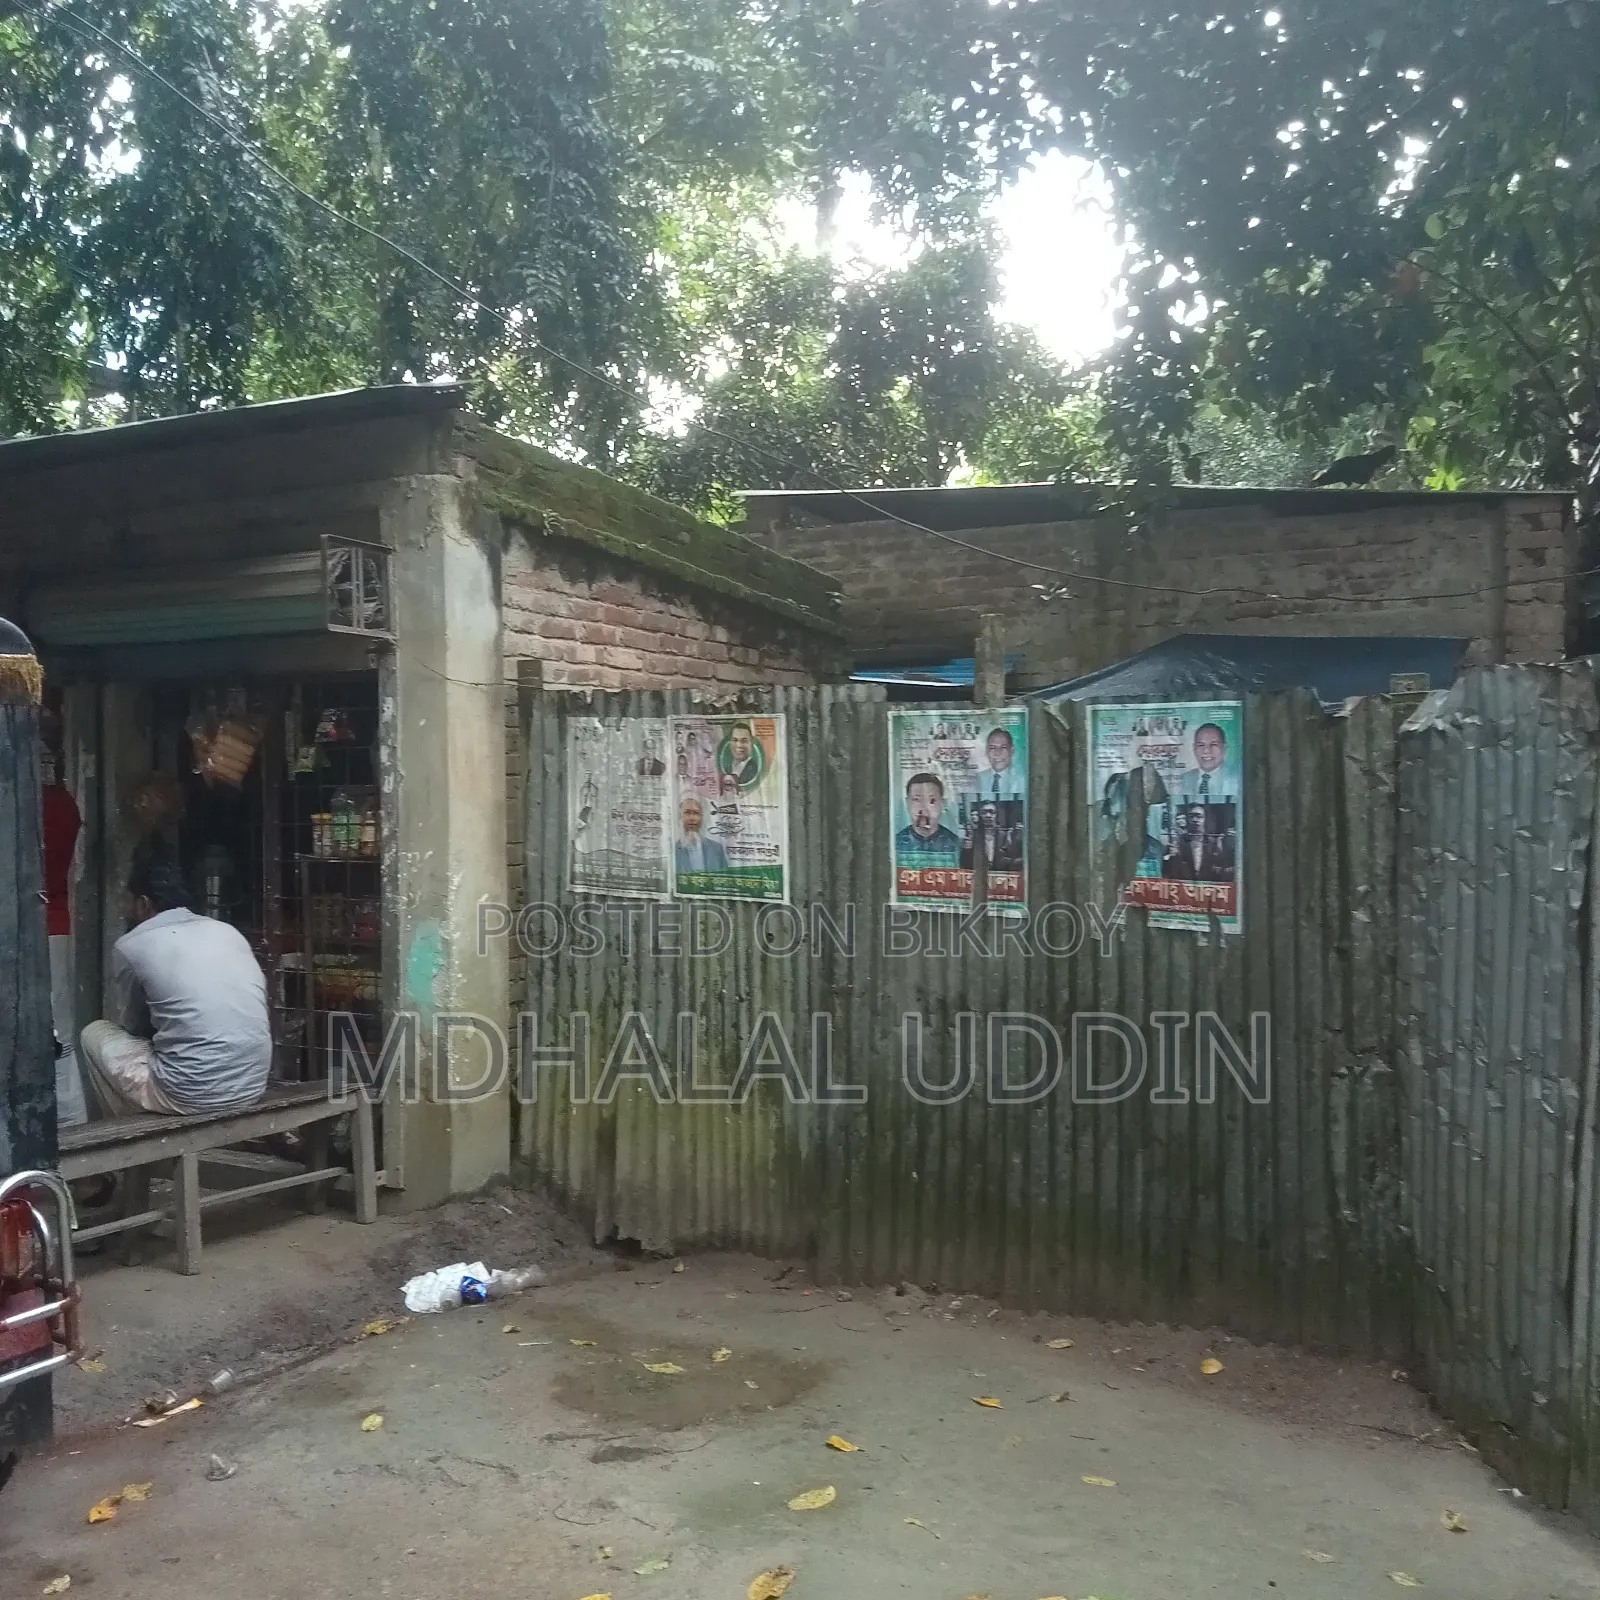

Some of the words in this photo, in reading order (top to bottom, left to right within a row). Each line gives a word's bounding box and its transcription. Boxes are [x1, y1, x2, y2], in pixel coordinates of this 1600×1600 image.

[924, 871, 948, 887] এম
[987, 873, 1020, 891] লম
[1181, 883, 1232, 904] আলম
